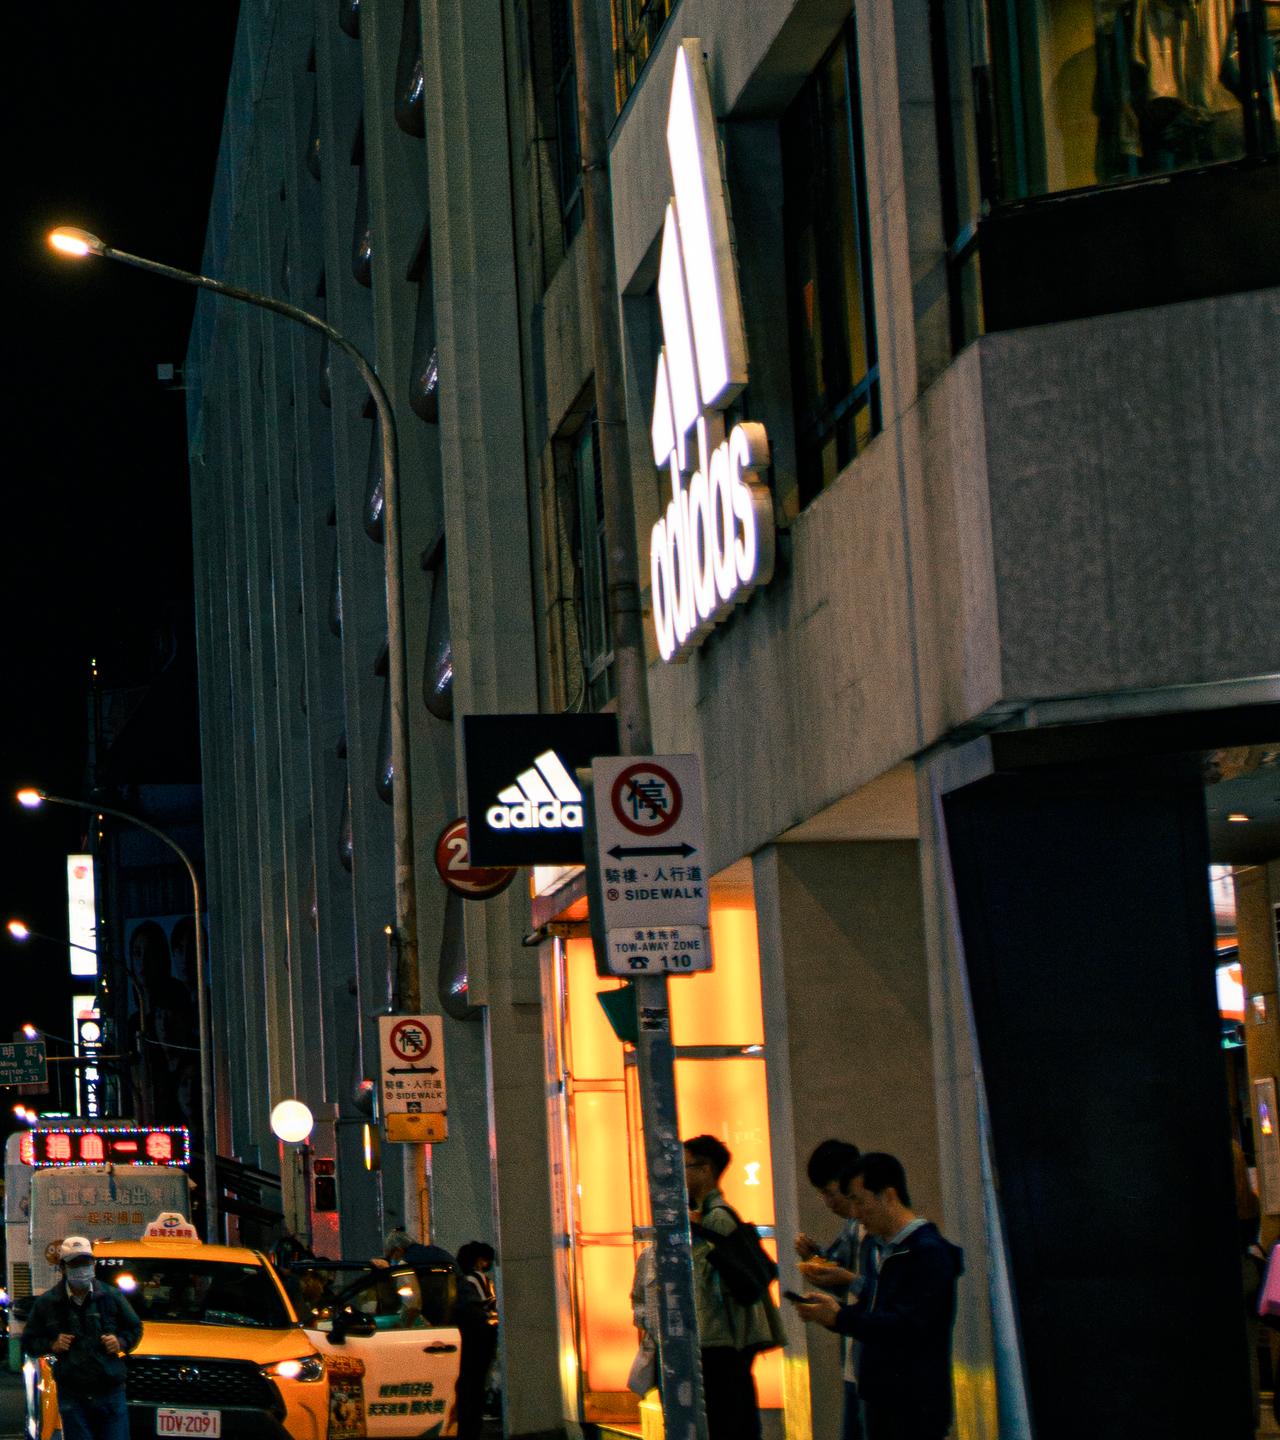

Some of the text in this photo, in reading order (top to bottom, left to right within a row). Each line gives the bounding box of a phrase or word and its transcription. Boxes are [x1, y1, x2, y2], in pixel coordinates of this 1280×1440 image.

[651, 417, 770, 665] adidas
[486, 799, 584, 829] adida
[625, 887, 704, 901] SIDEWALK
[615, 940, 701, 953] TOW-AWAY ZONE
[660, 955, 691, 969] 110
[395, 1091, 443, 1100] SIDEWALK
[45, 1132, 172, 1161] 捐血一袋
[157, 1415, 218, 1436] TDV-2091
